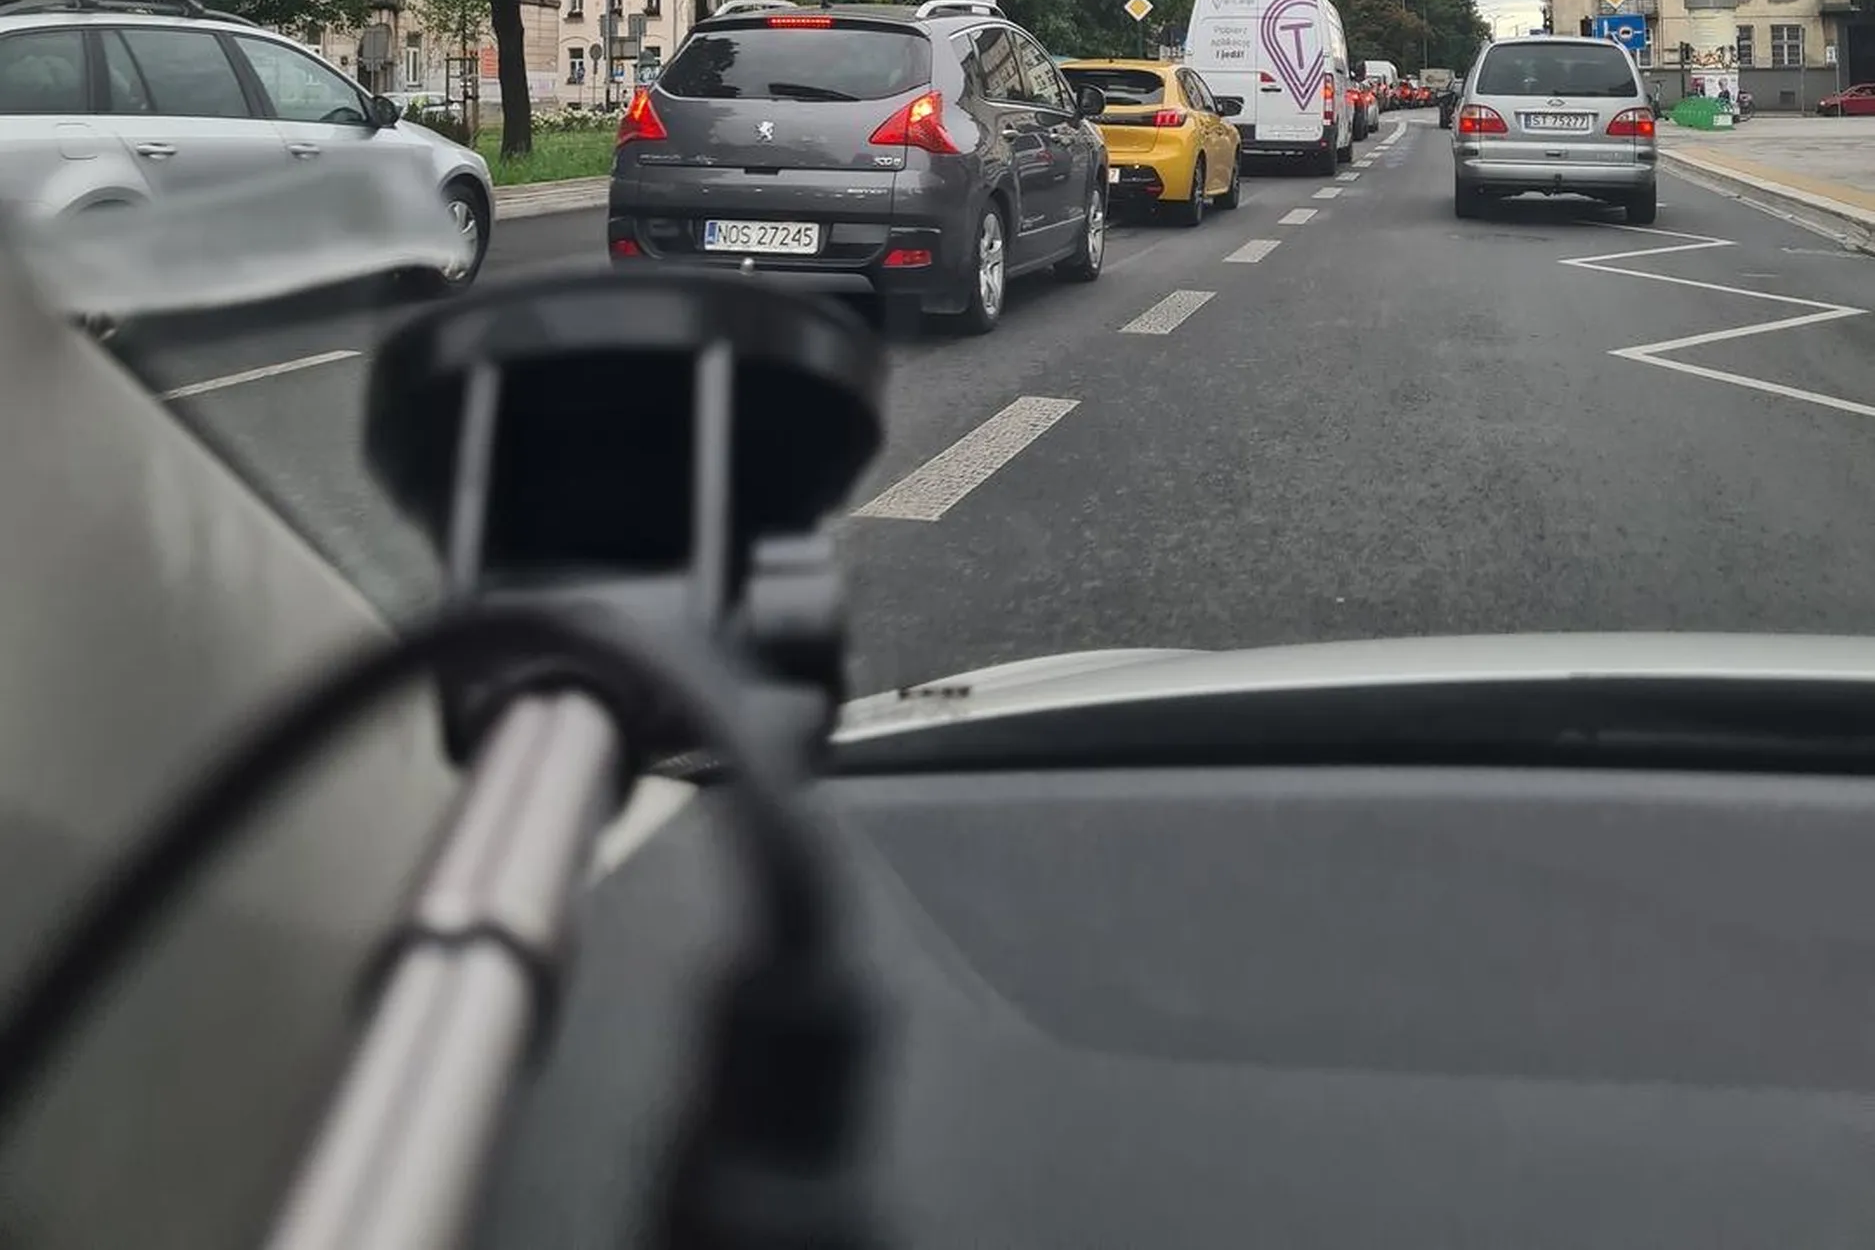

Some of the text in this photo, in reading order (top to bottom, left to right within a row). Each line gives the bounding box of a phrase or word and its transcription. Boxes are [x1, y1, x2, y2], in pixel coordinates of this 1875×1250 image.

[1279, 21, 1314, 70] T
[718, 224, 814, 247] NOS 27245
